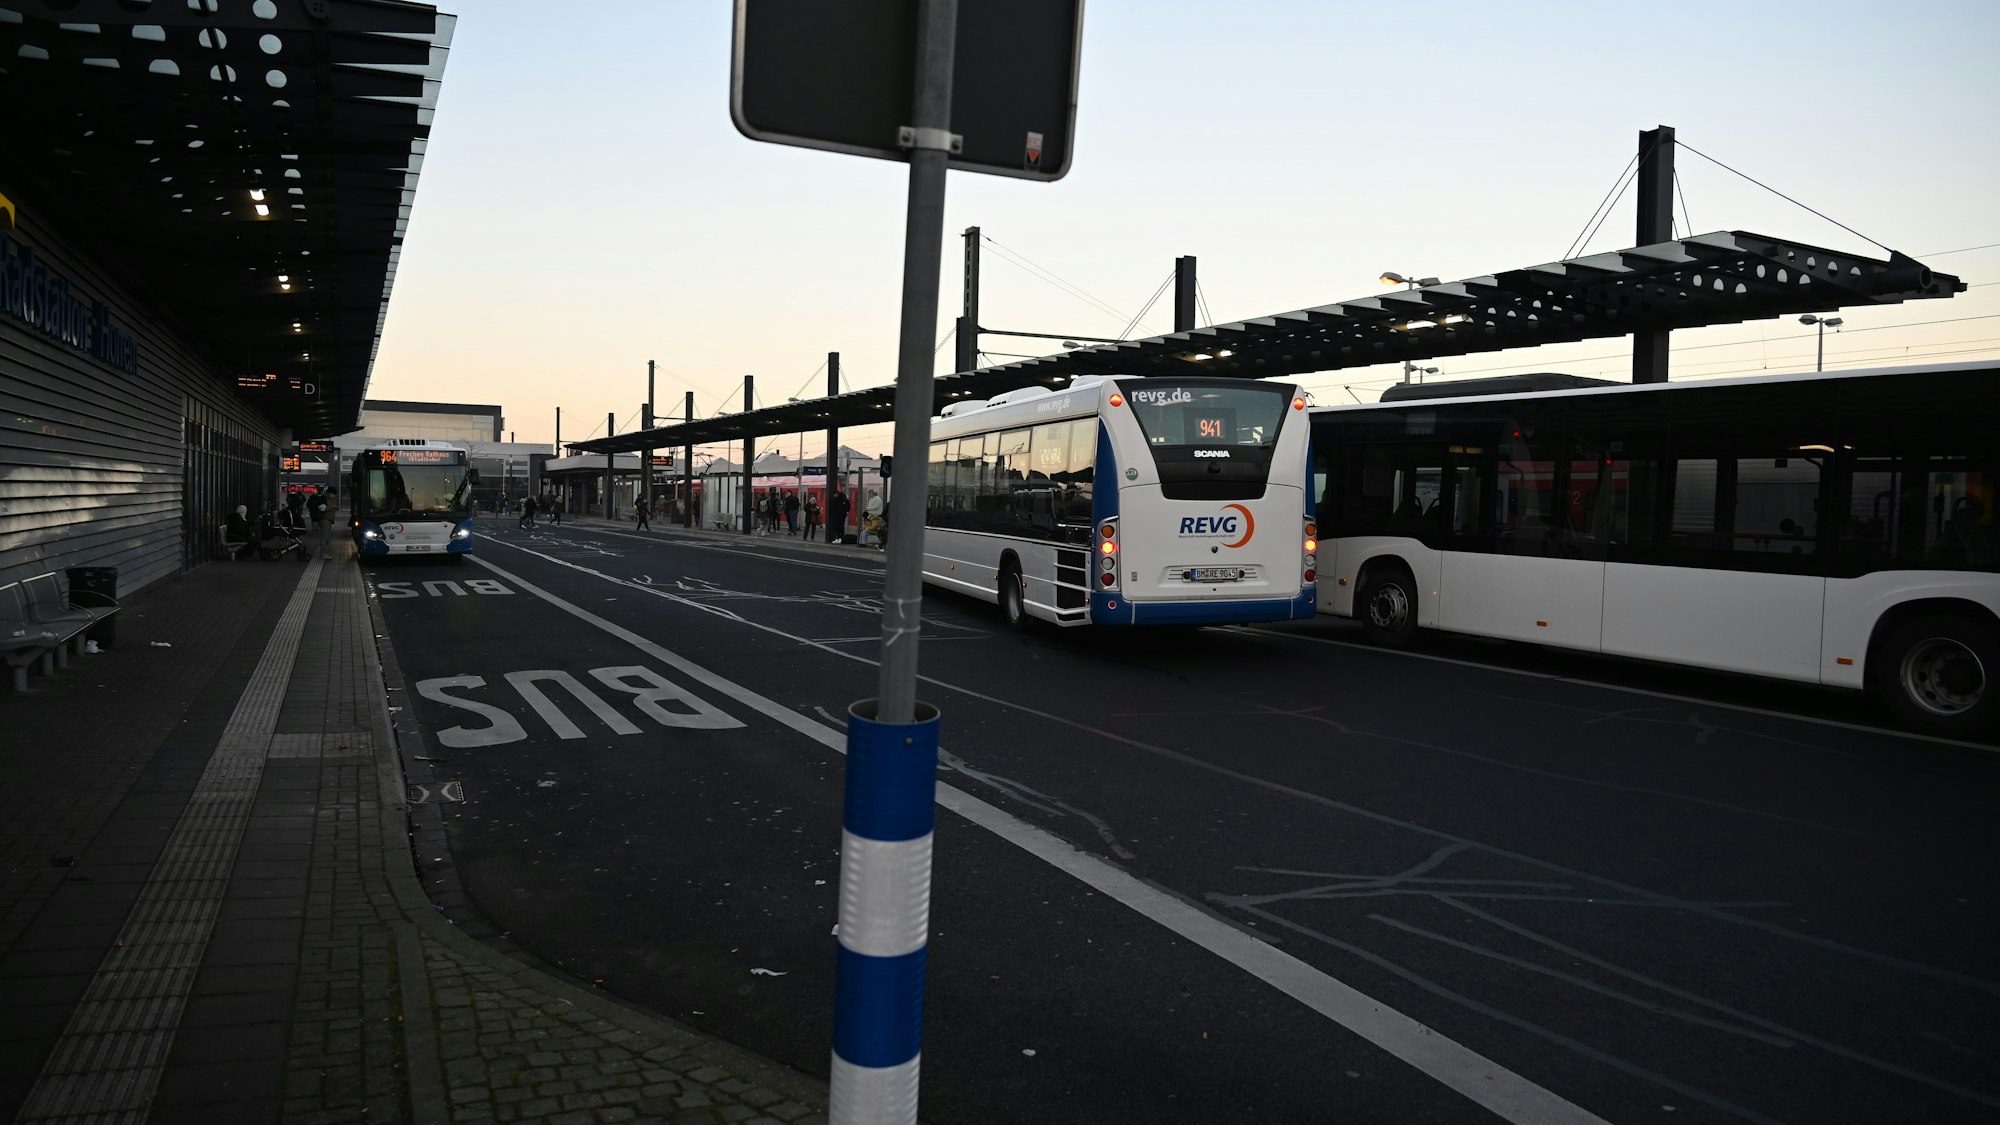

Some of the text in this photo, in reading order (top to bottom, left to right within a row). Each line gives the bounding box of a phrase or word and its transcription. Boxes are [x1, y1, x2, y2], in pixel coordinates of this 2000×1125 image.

[304, 382, 316, 395] D
[1131, 387, 1192, 405] revg.de
[1036, 395, 1071, 413] www.revg.de
[1199, 418, 1221, 438] 941
[380, 450, 397, 463] 964
[425, 450, 449, 458] Rathaus
[1193, 449, 1231, 459] SCANIA
[1179, 516, 1237, 534] REVG
[1196, 570, 1206, 578] BM
[1209, 570, 1219, 578] RE
[377, 579, 516, 598] BUS
[414, 665, 748, 748] BUS
